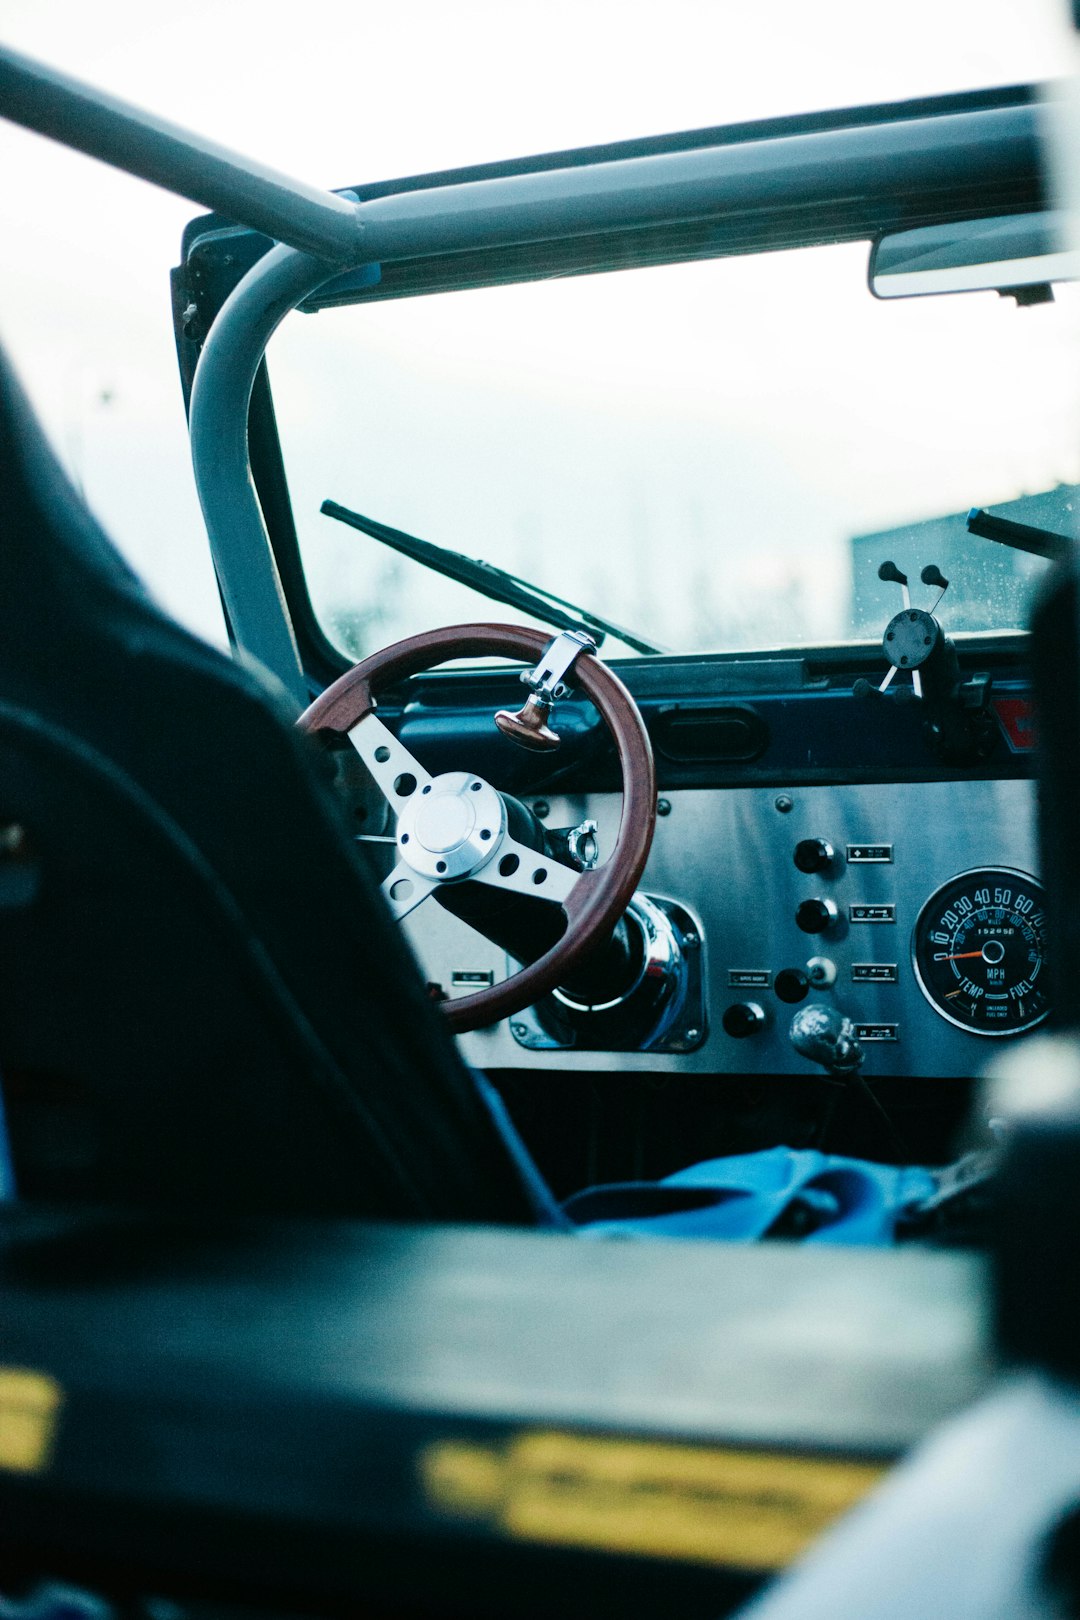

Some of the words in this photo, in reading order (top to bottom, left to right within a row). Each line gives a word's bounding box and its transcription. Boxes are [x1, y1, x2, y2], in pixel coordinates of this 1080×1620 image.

[974, 888, 990, 904] 40
[994, 888, 1011, 905] 50
[1014, 894, 1034, 914] 60
[954, 896, 973, 915] 30
[941, 910, 959, 929] 20
[994, 910, 1005, 919] 80
[1009, 913, 1023, 927] 100
[934, 931, 950, 945] 10
[1021, 926, 1034, 941] 120
[934, 952, 949, 961] 0
[986, 968, 1005, 980] MPH
[959, 976, 984, 999] TEMP
[1010, 980, 1033, 1000] FUEL
